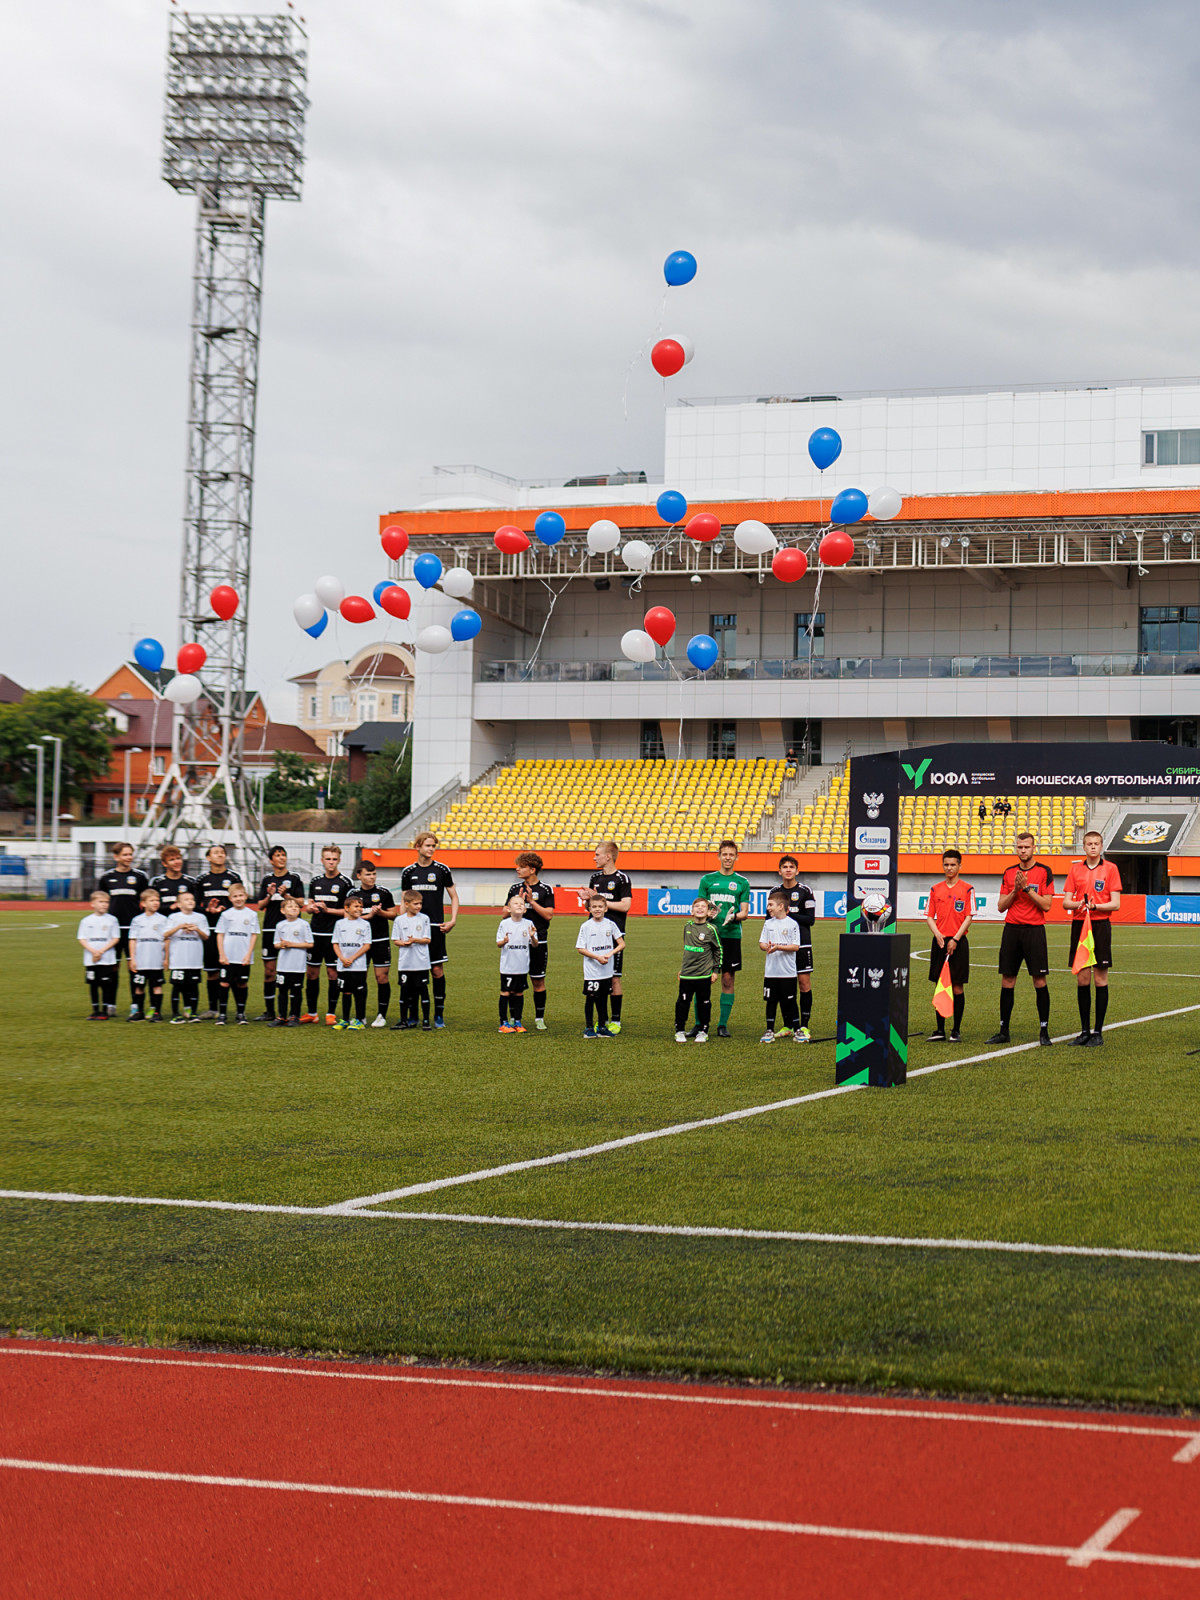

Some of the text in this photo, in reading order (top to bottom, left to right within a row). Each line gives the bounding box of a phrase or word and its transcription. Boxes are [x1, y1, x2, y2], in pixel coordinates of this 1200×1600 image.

[930, 772, 968, 785] ЮФЛ
[1016, 775, 1091, 785] ЮНОШЕСКАЯ
[1094, 775, 1172, 785] ФУТБОЛЬНАЯ
[401, 974, 408, 983] 9
[506, 977, 513, 987] 7
[587, 981, 600, 991] 29
